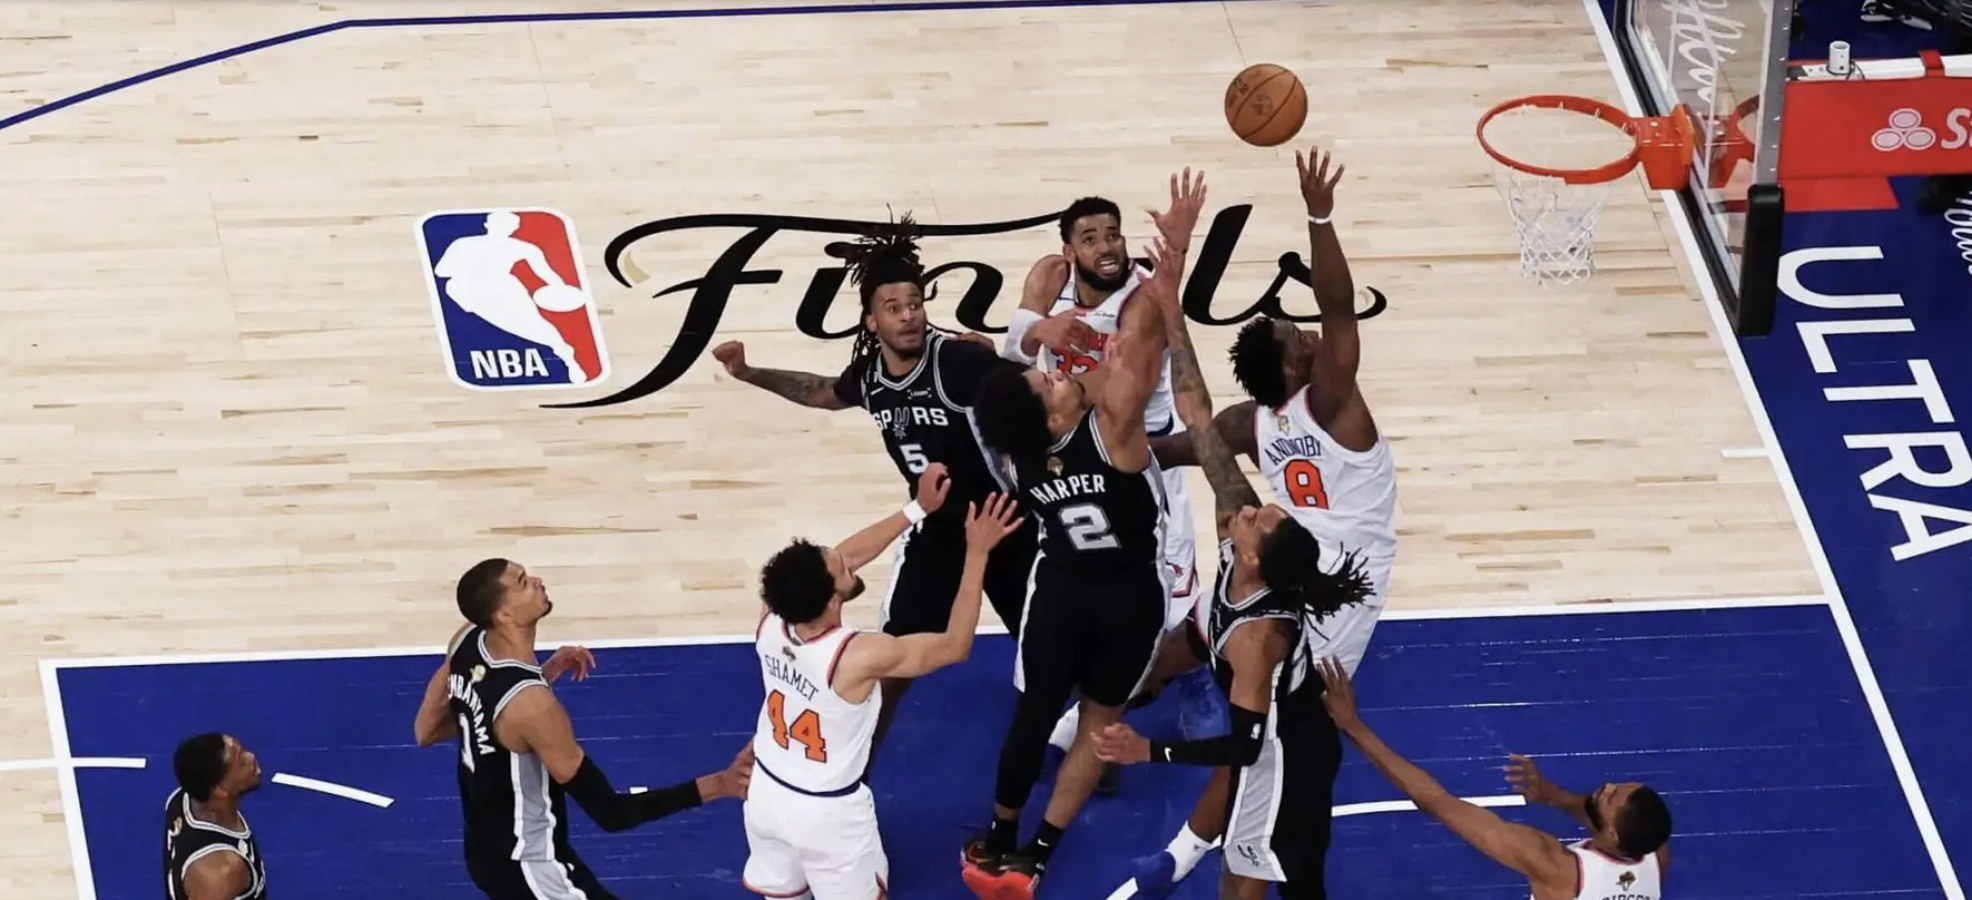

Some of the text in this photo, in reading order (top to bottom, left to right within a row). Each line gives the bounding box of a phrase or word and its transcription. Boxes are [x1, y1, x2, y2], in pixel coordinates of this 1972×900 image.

[1941, 108, 1972, 149] S
[540, 203, 1387, 409] Finls
[470, 348, 549, 379] NBA
[1777, 246, 1972, 561] ULTRA
[899, 443, 930, 475] 5
[1283, 458, 1329, 510] 8
[1029, 474, 1106, 505] HARPER
[1058, 503, 1121, 551] 2
[764, 654, 819, 701] SHAMET
[448, 674, 496, 755] MBANYAMA
[766, 689, 827, 763] 44
[459, 712, 475, 774] 1
